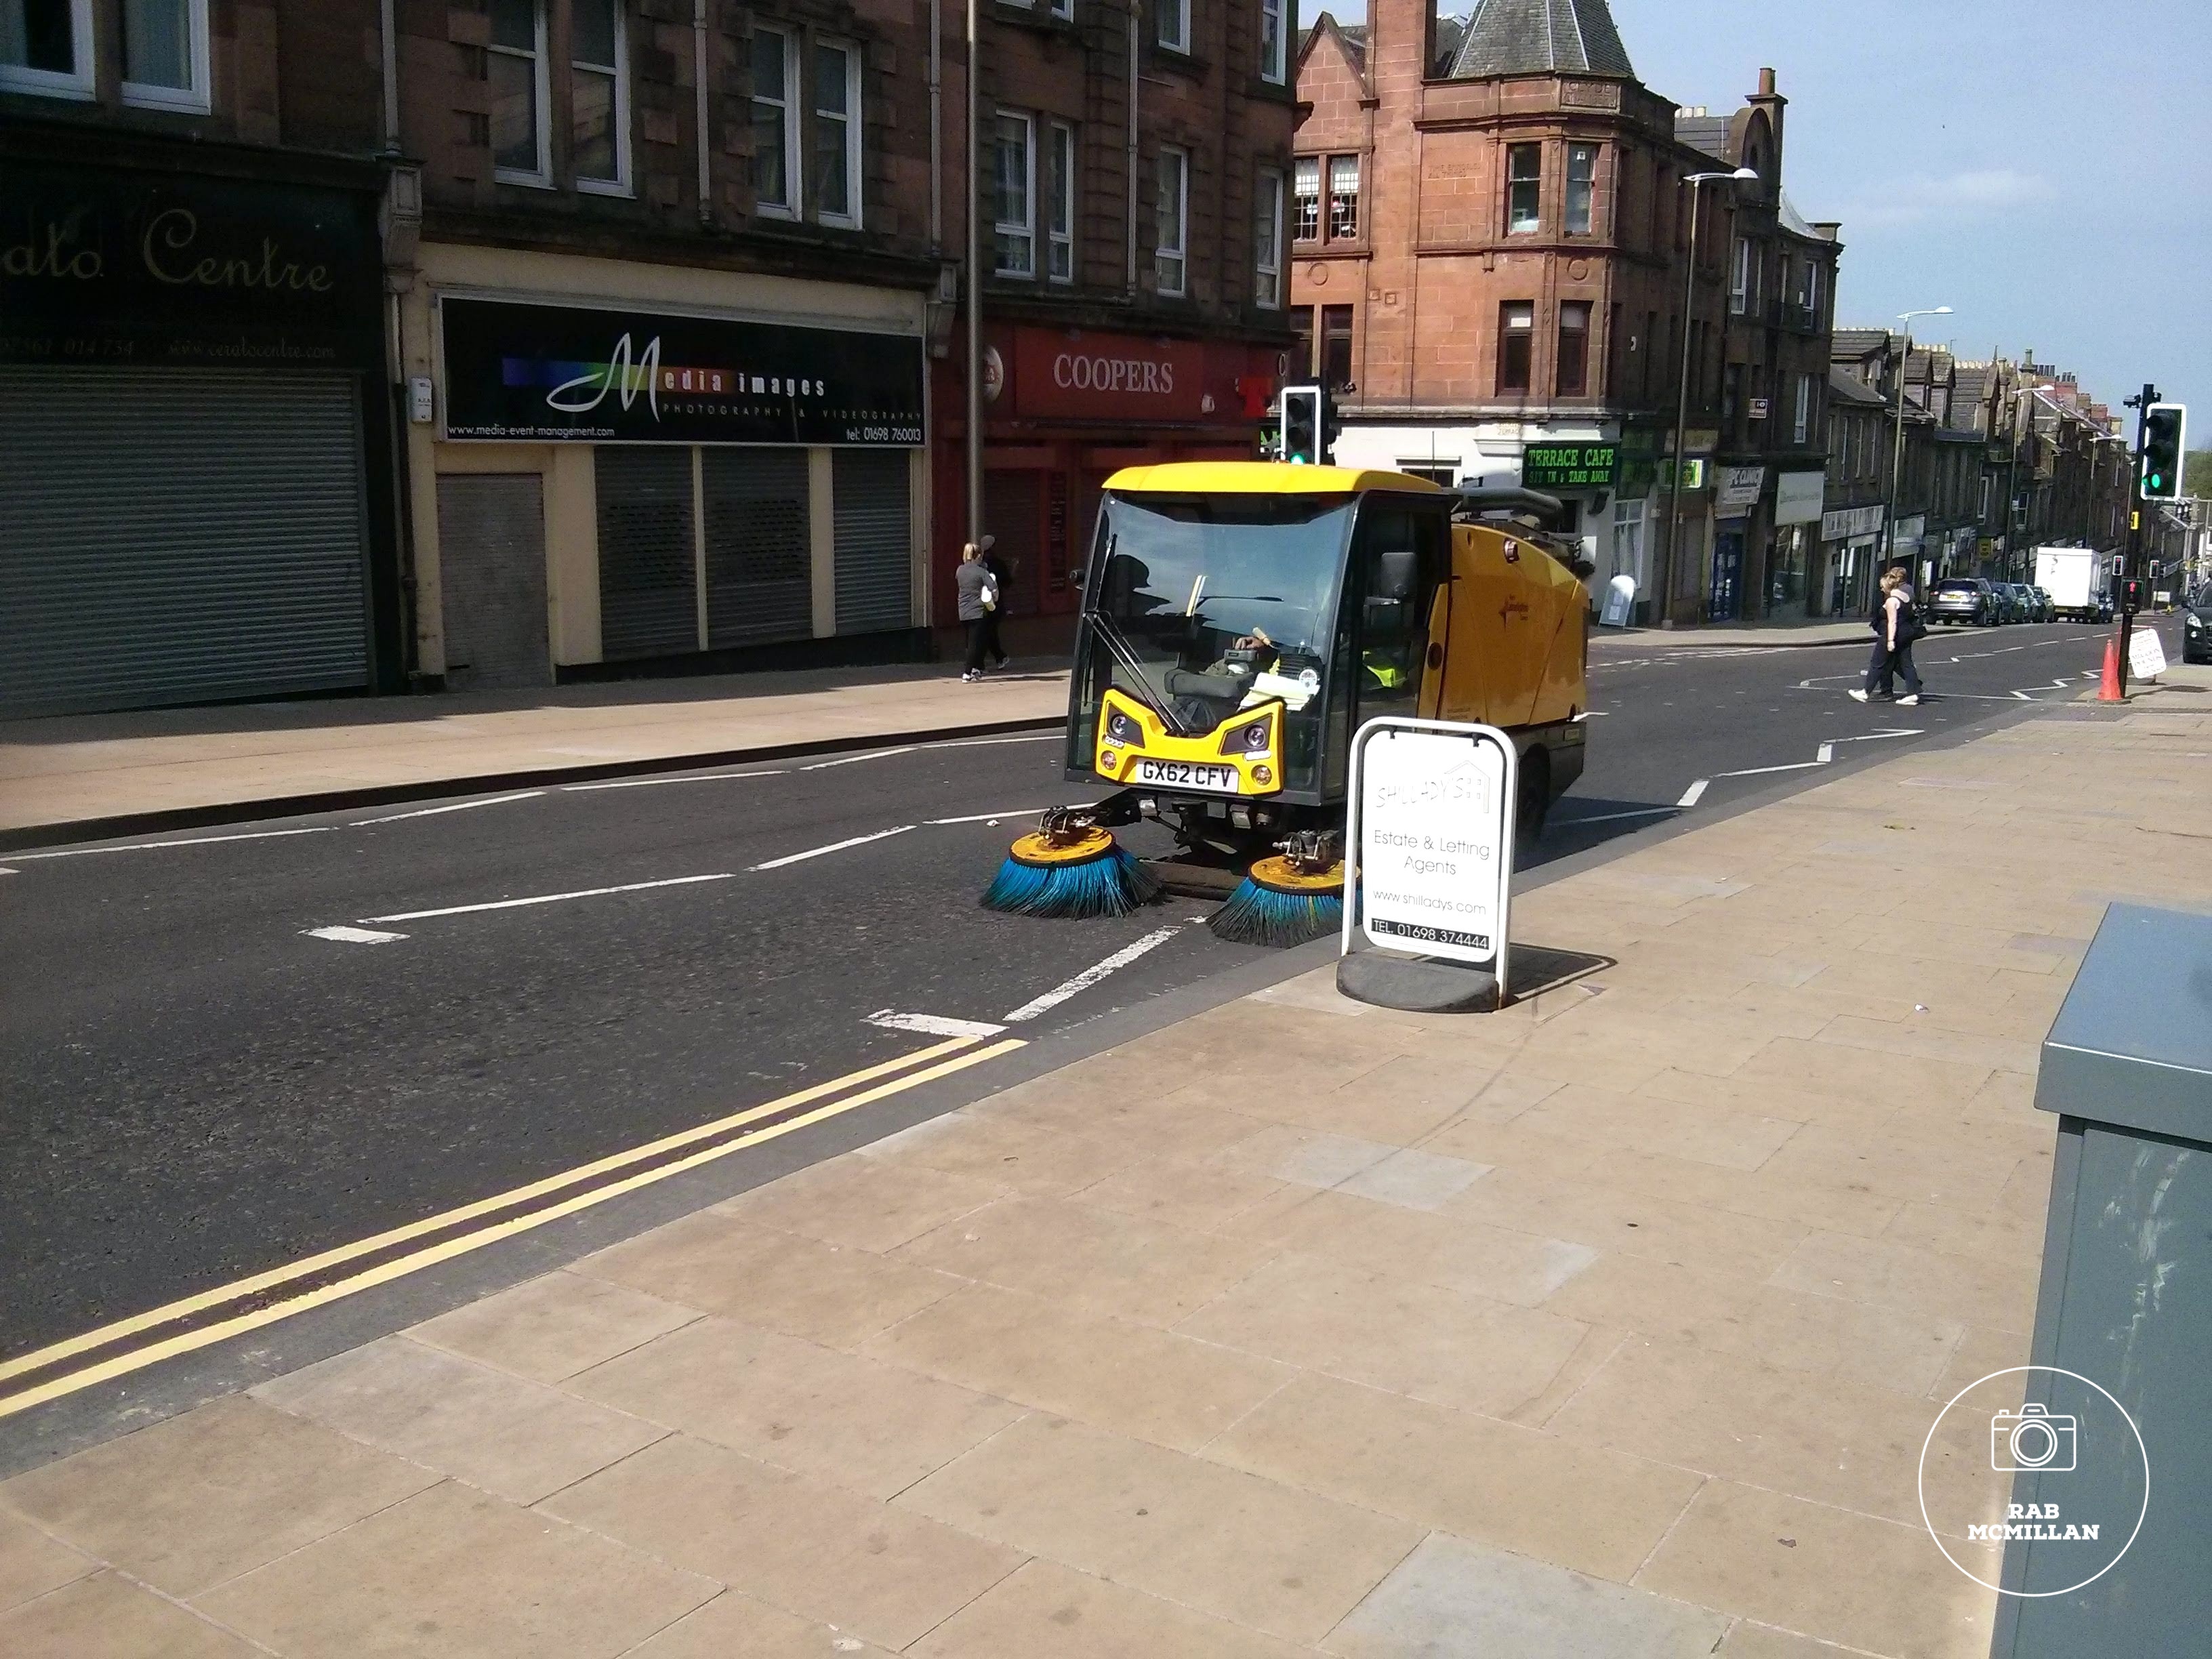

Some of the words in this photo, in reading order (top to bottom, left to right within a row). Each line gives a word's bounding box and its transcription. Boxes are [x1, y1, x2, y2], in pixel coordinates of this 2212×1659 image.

[142, 208, 334, 292] Centre
[738, 372, 825, 397] images
[1053, 354, 1173, 394] COOPERS
[663, 405, 782, 417] PHOTOGRAPHY
[823, 410, 922, 420] VIDEOGRAPHY
[448, 424, 615, 438] www.media-event-management.com
[863, 428, 888, 441] 01698
[892, 428, 921, 441] 760013
[1528, 449, 1579, 467] TERRACE
[1584, 448, 1614, 467] CAFE
[1548, 471, 1557, 483] IN
[1568, 470, 1587, 483] TAKE
[1591, 470, 1610, 483] AWAY
[1143, 761, 1189, 783] GX62
[1195, 764, 1231, 787] CFV
[1374, 830, 1418, 848] Estate
[1423, 836, 1433, 849] &
[1440, 836, 1490, 860] Letting
[1404, 855, 1456, 875] Agents
[1373, 920, 1393, 935] TEL.
[1397, 923, 1436, 941] 01698
[1440, 930, 1488, 949] 374444
